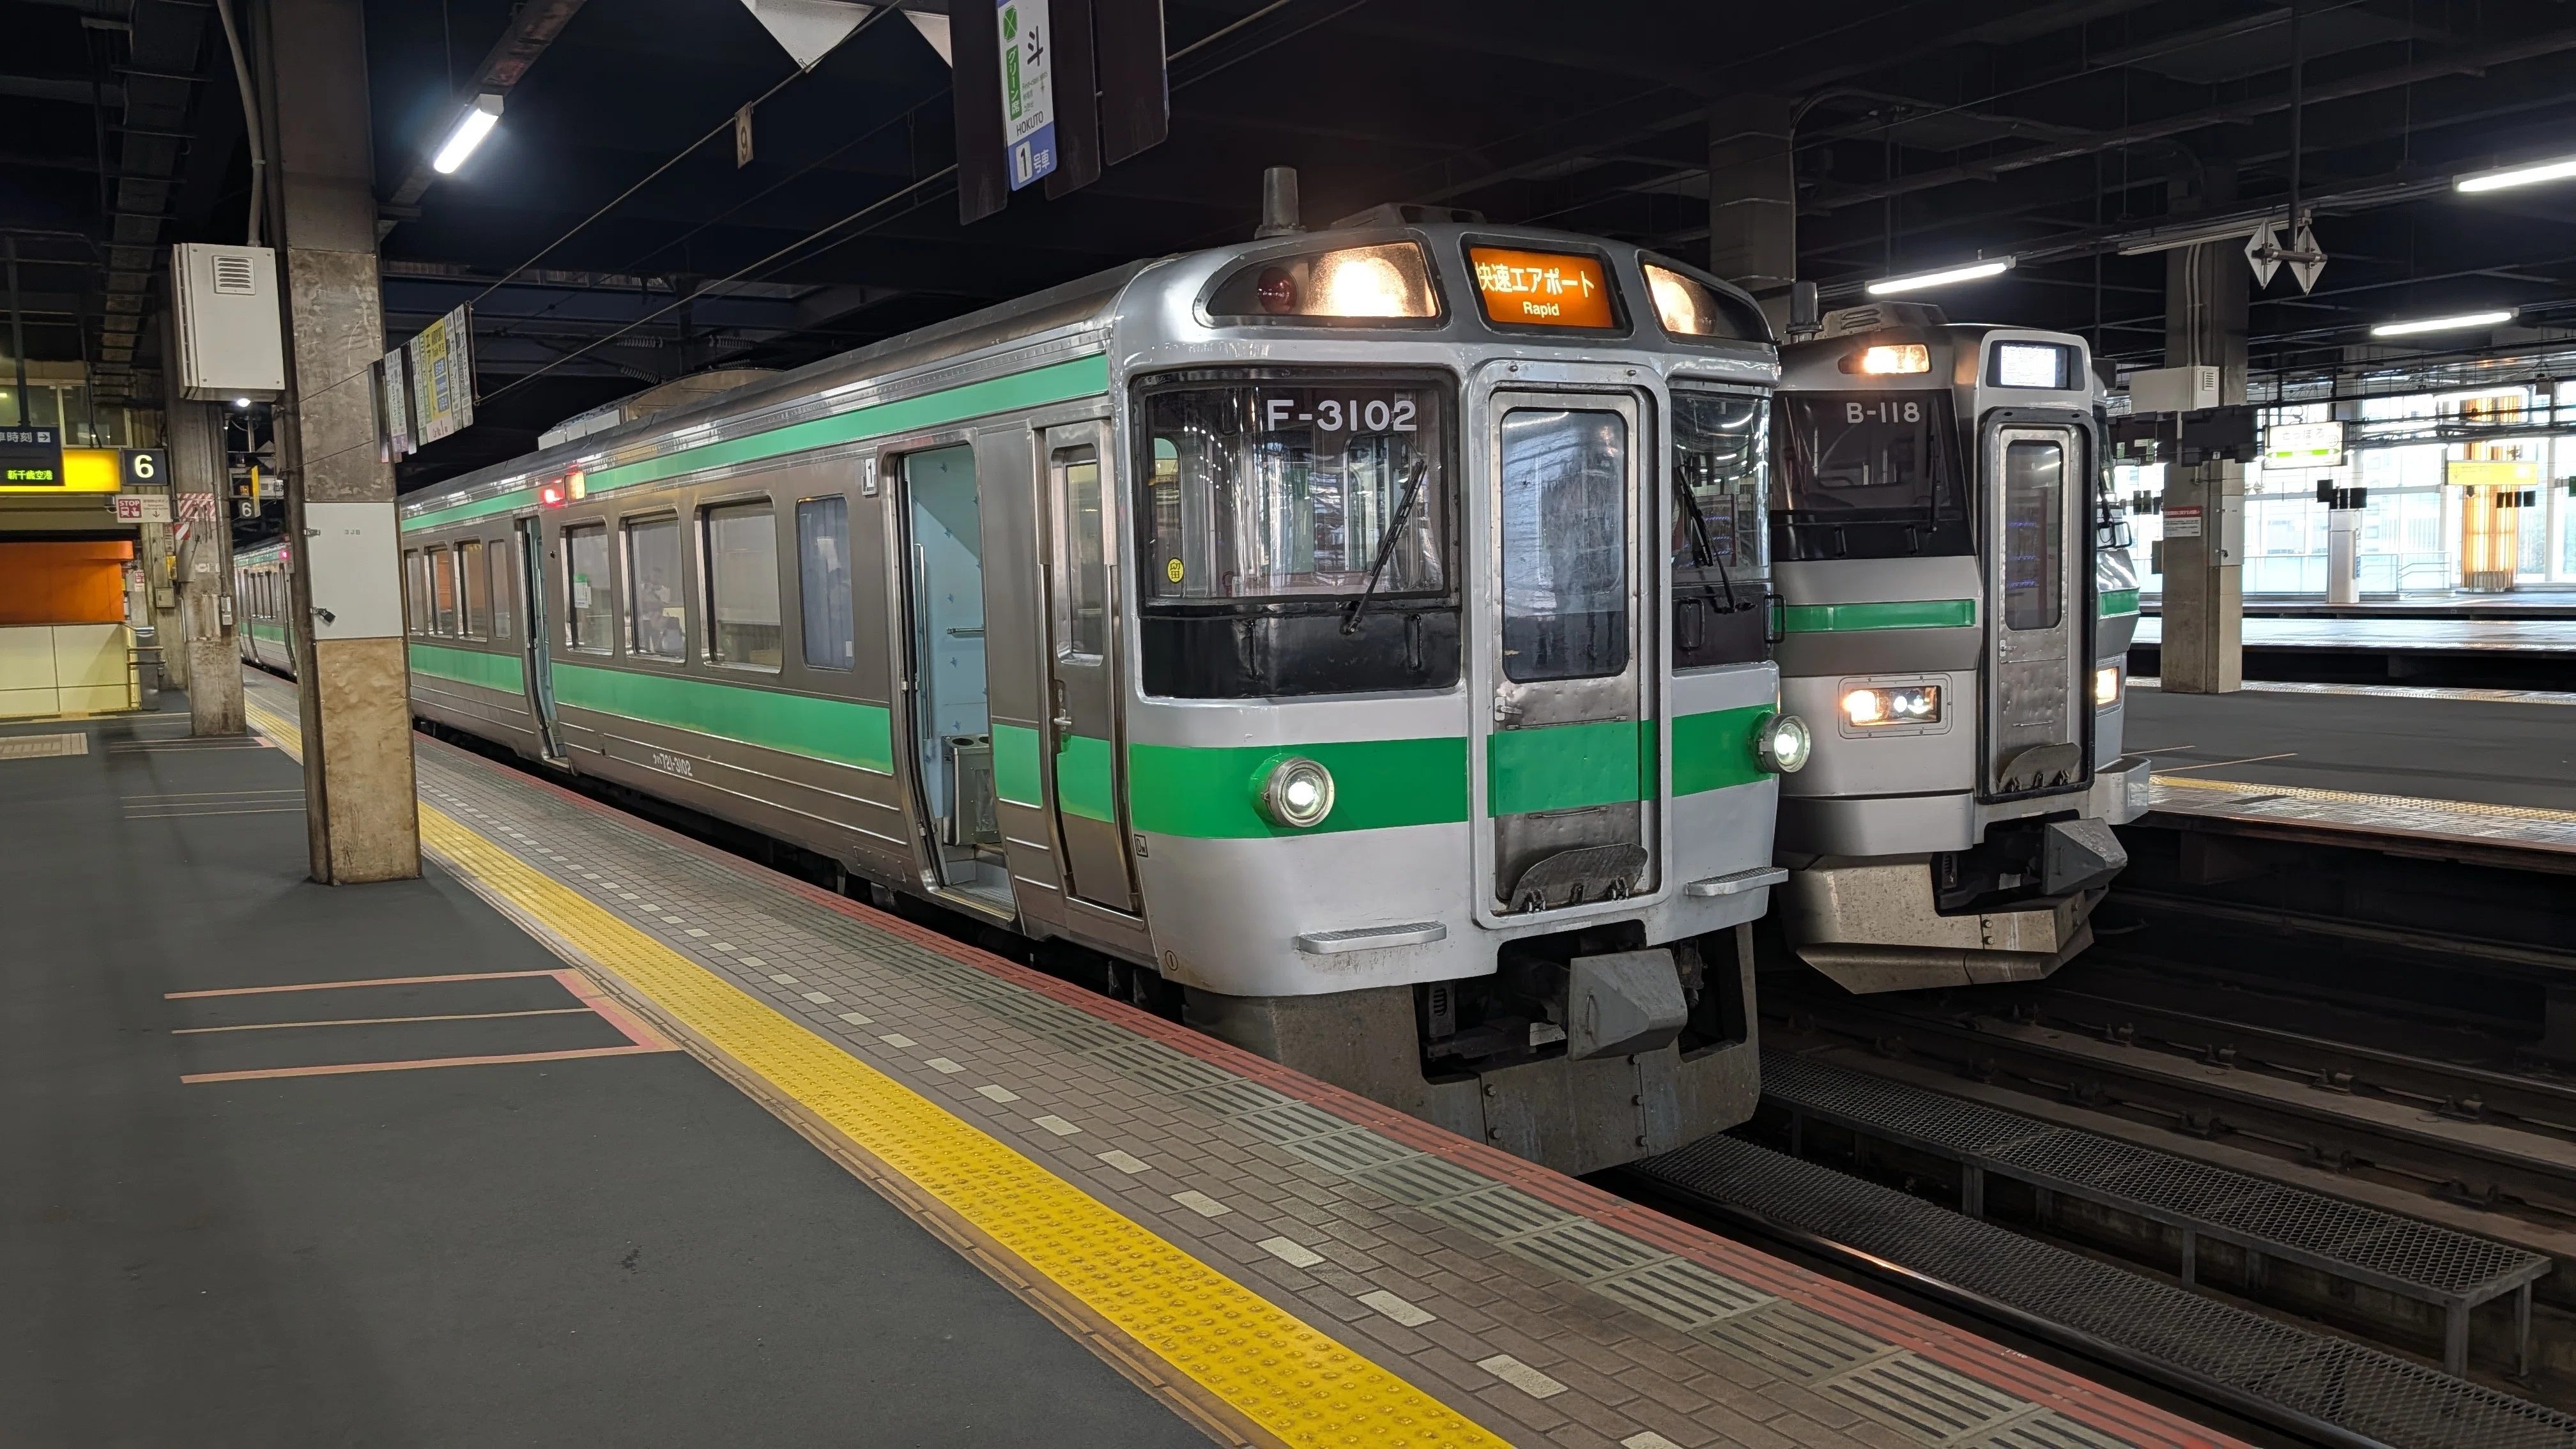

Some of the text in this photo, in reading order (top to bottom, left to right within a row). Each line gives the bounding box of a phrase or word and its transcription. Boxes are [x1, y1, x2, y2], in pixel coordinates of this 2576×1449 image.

[1027, 25, 1044, 67] 斗
[1008, 47, 1020, 116] グリーン席
[1016, 111, 1044, 137] HOKUTO
[741, 126, 747, 162] 9
[1475, 261, 1595, 298] 快速エアポート
[1522, 301, 1560, 318] Rapid
[1267, 399, 1417, 431] F-3102
[1846, 402, 1920, 423] B-118
[2283, 428, 2324, 440] さっぽろ
[7, 470, 53, 480] 新千歳空港
[134, 454, 155, 479] 6
[868, 462, 873, 484] 1
[241, 502, 252, 518] 6
[1170, 562, 1181, 579] 留
